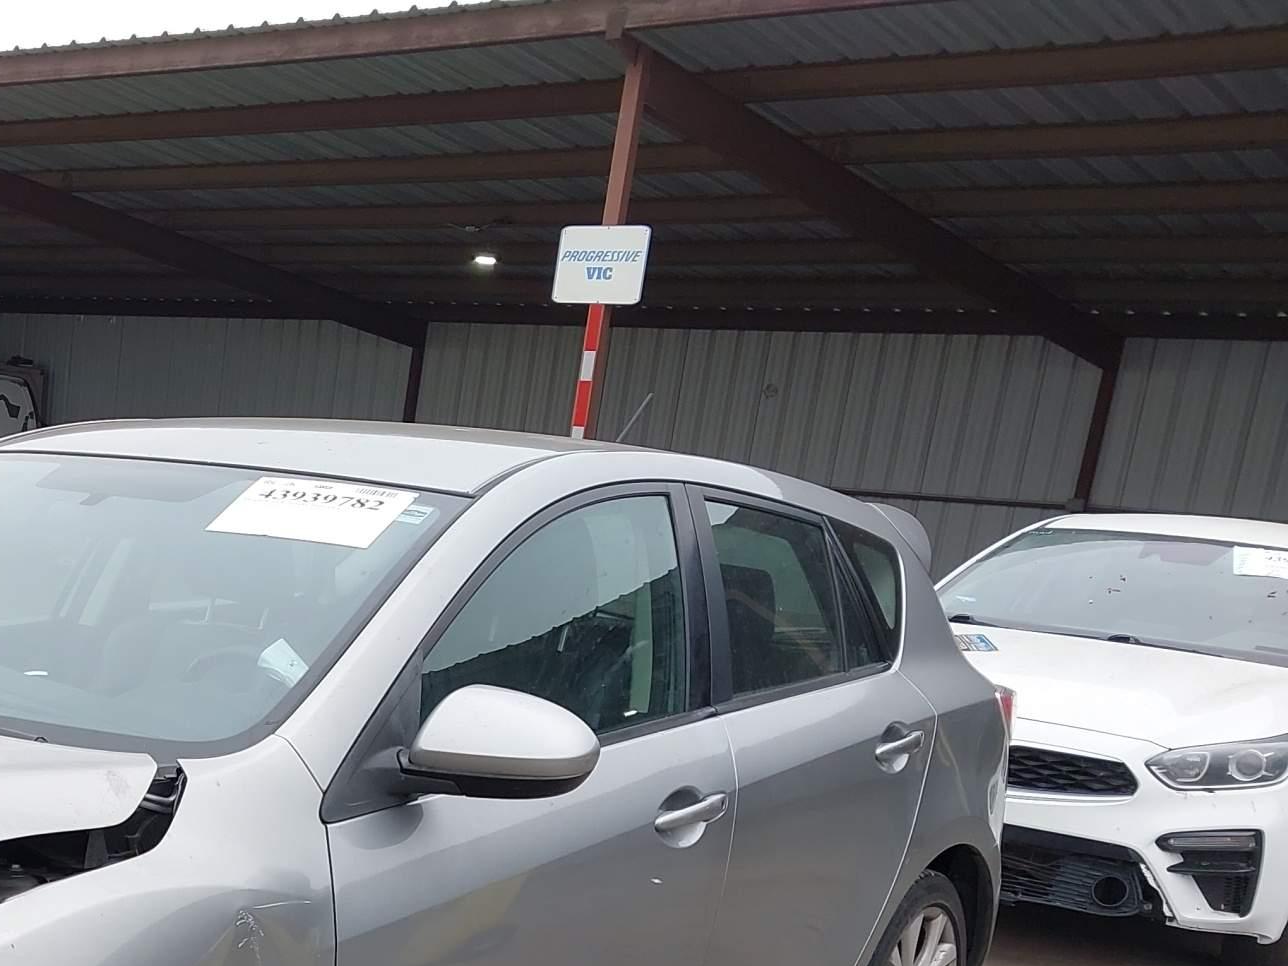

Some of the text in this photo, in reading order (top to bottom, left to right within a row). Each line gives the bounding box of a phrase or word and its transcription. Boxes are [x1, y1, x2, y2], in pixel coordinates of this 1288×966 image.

[561, 250, 643, 263] PROGRESSIVE
[586, 267, 614, 280] VIC
[258, 488, 385, 511] 43939782
